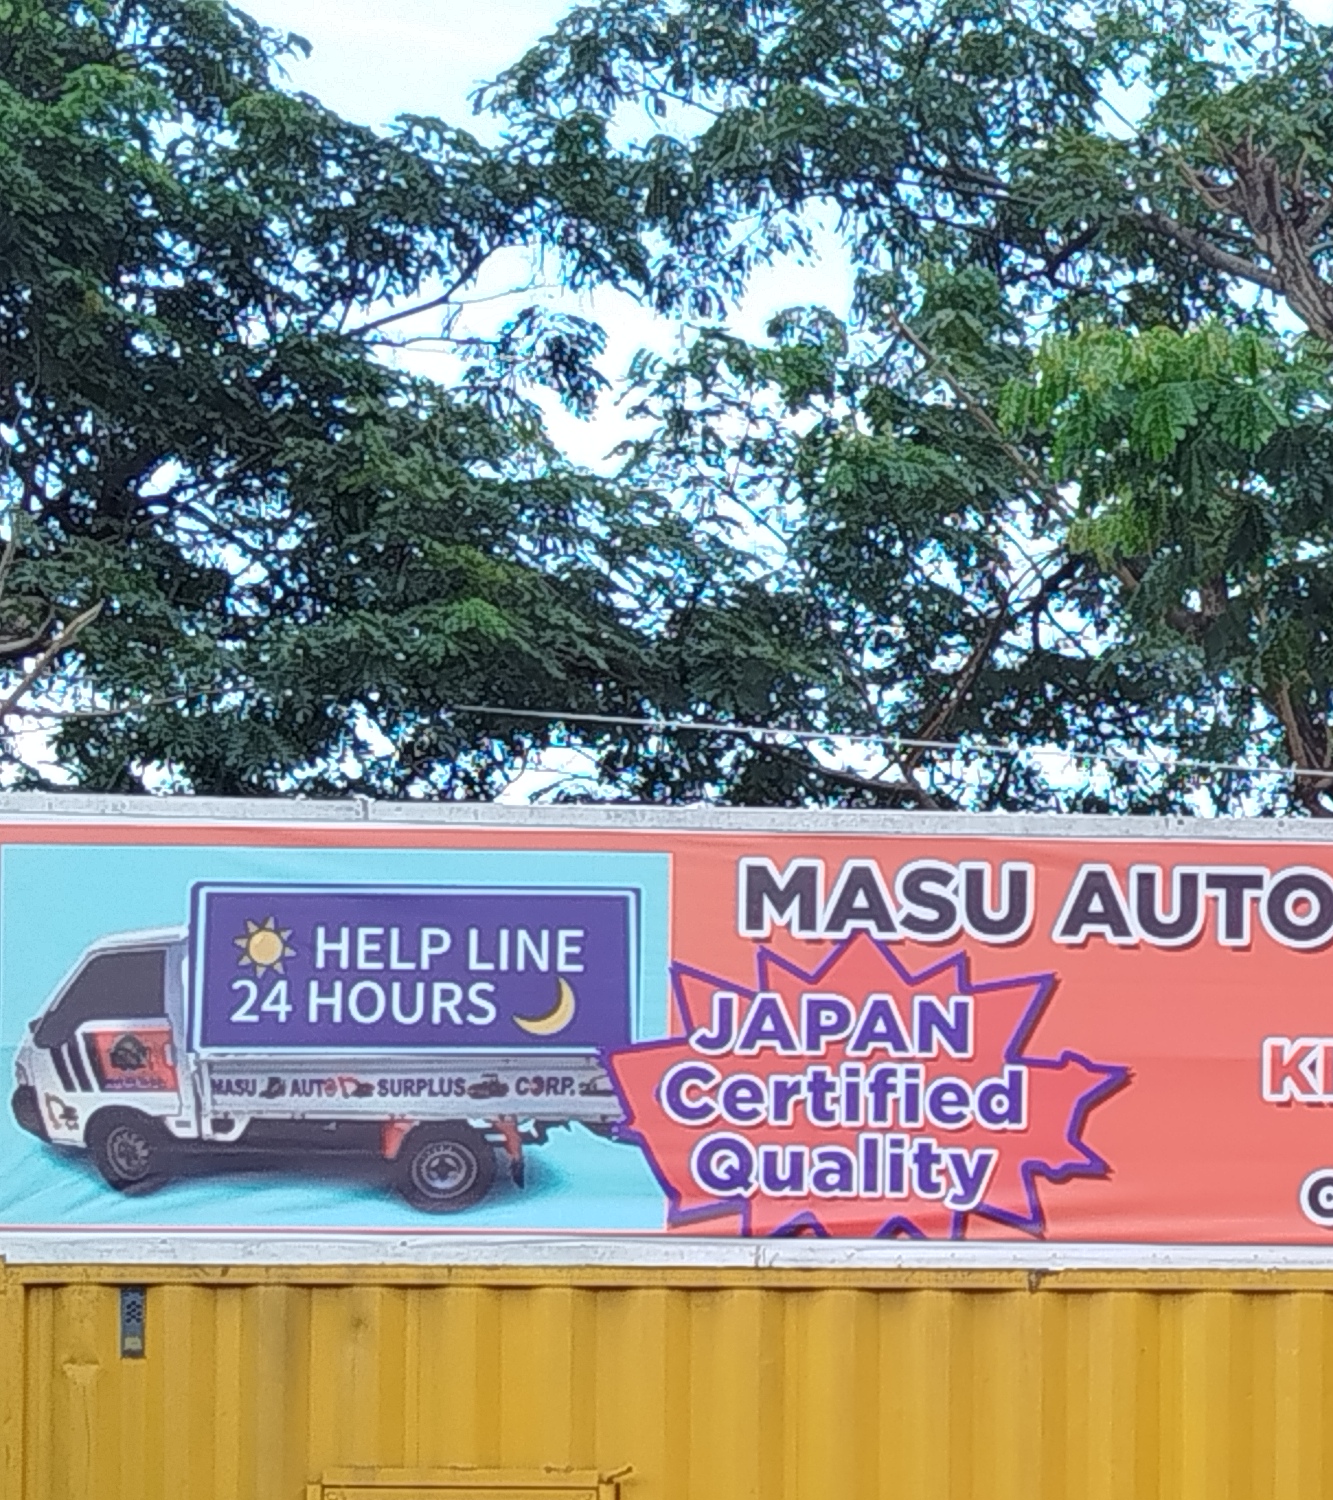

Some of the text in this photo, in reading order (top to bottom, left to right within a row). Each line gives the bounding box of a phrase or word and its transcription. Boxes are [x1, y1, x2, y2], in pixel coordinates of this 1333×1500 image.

[742, 858, 1031, 940] MASU
[314, 924, 586, 974] HELP LINE
[228, 978, 499, 1027] 24 HOURS
[690, 993, 973, 1057] JAPAN
[210, 1075, 576, 1098] MASU AUTO SURPLUS CORP.
[661, 1063, 1026, 1127] Certified
[693, 1134, 997, 1207] Quality
